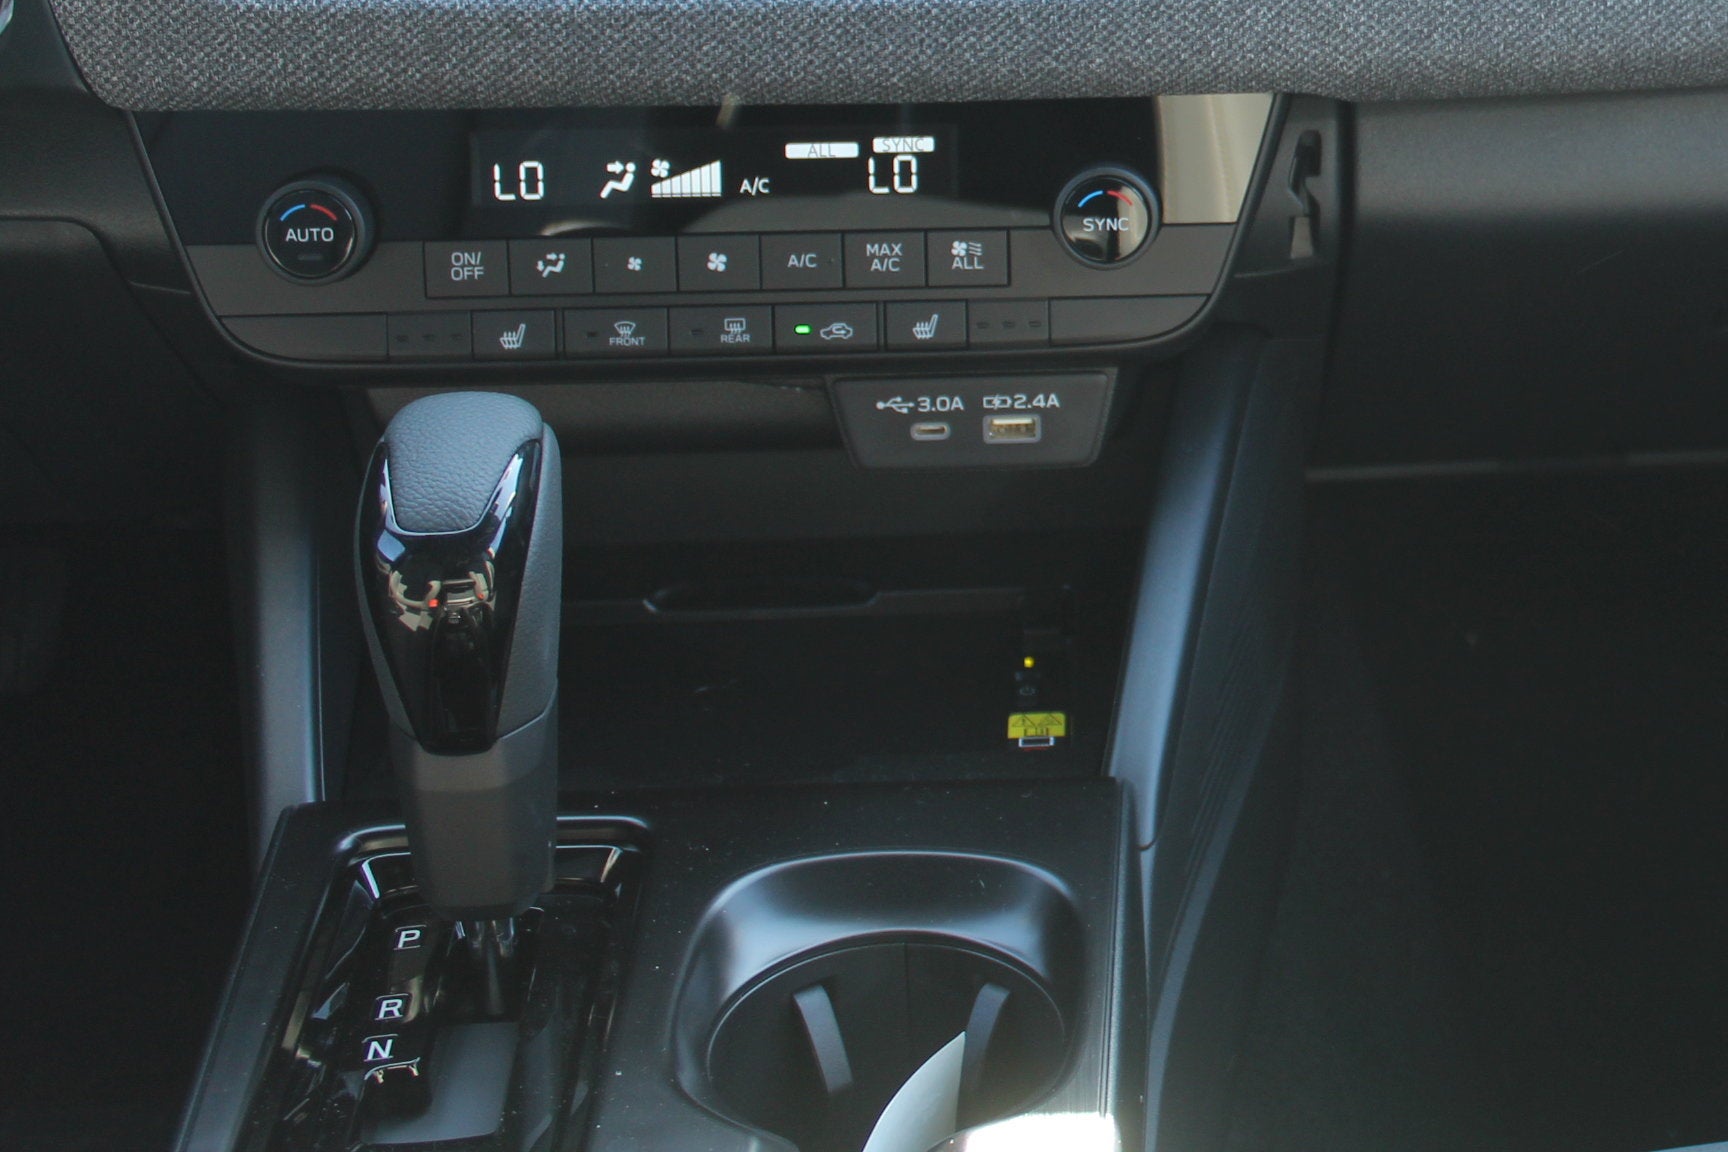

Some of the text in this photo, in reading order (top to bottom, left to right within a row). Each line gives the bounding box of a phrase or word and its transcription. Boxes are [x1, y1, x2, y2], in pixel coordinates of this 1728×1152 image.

[805, 143, 838, 159] ALL
[881, 137, 926, 153] SYNC
[492, 159, 545, 201] LO
[867, 154, 919, 195] LO
[739, 176, 771, 196] A/C
[1082, 217, 1130, 233] SYNC
[285, 226, 335, 243] AUTO
[865, 243, 903, 257] MAX
[450, 251, 482, 266] ON/
[787, 254, 818, 269] A/C
[870, 257, 902, 272] A/C
[951, 256, 985, 270] ALL
[450, 266, 485, 281] OFF
[608, 335, 647, 347] FRONT
[720, 333, 752, 344] REAR
[916, 396, 966, 413] 3.0A
[1012, 393, 1061, 410] 2.4A
[397, 929, 421, 948] P
[378, 998, 403, 1019] R
[367, 1038, 393, 1059] N
